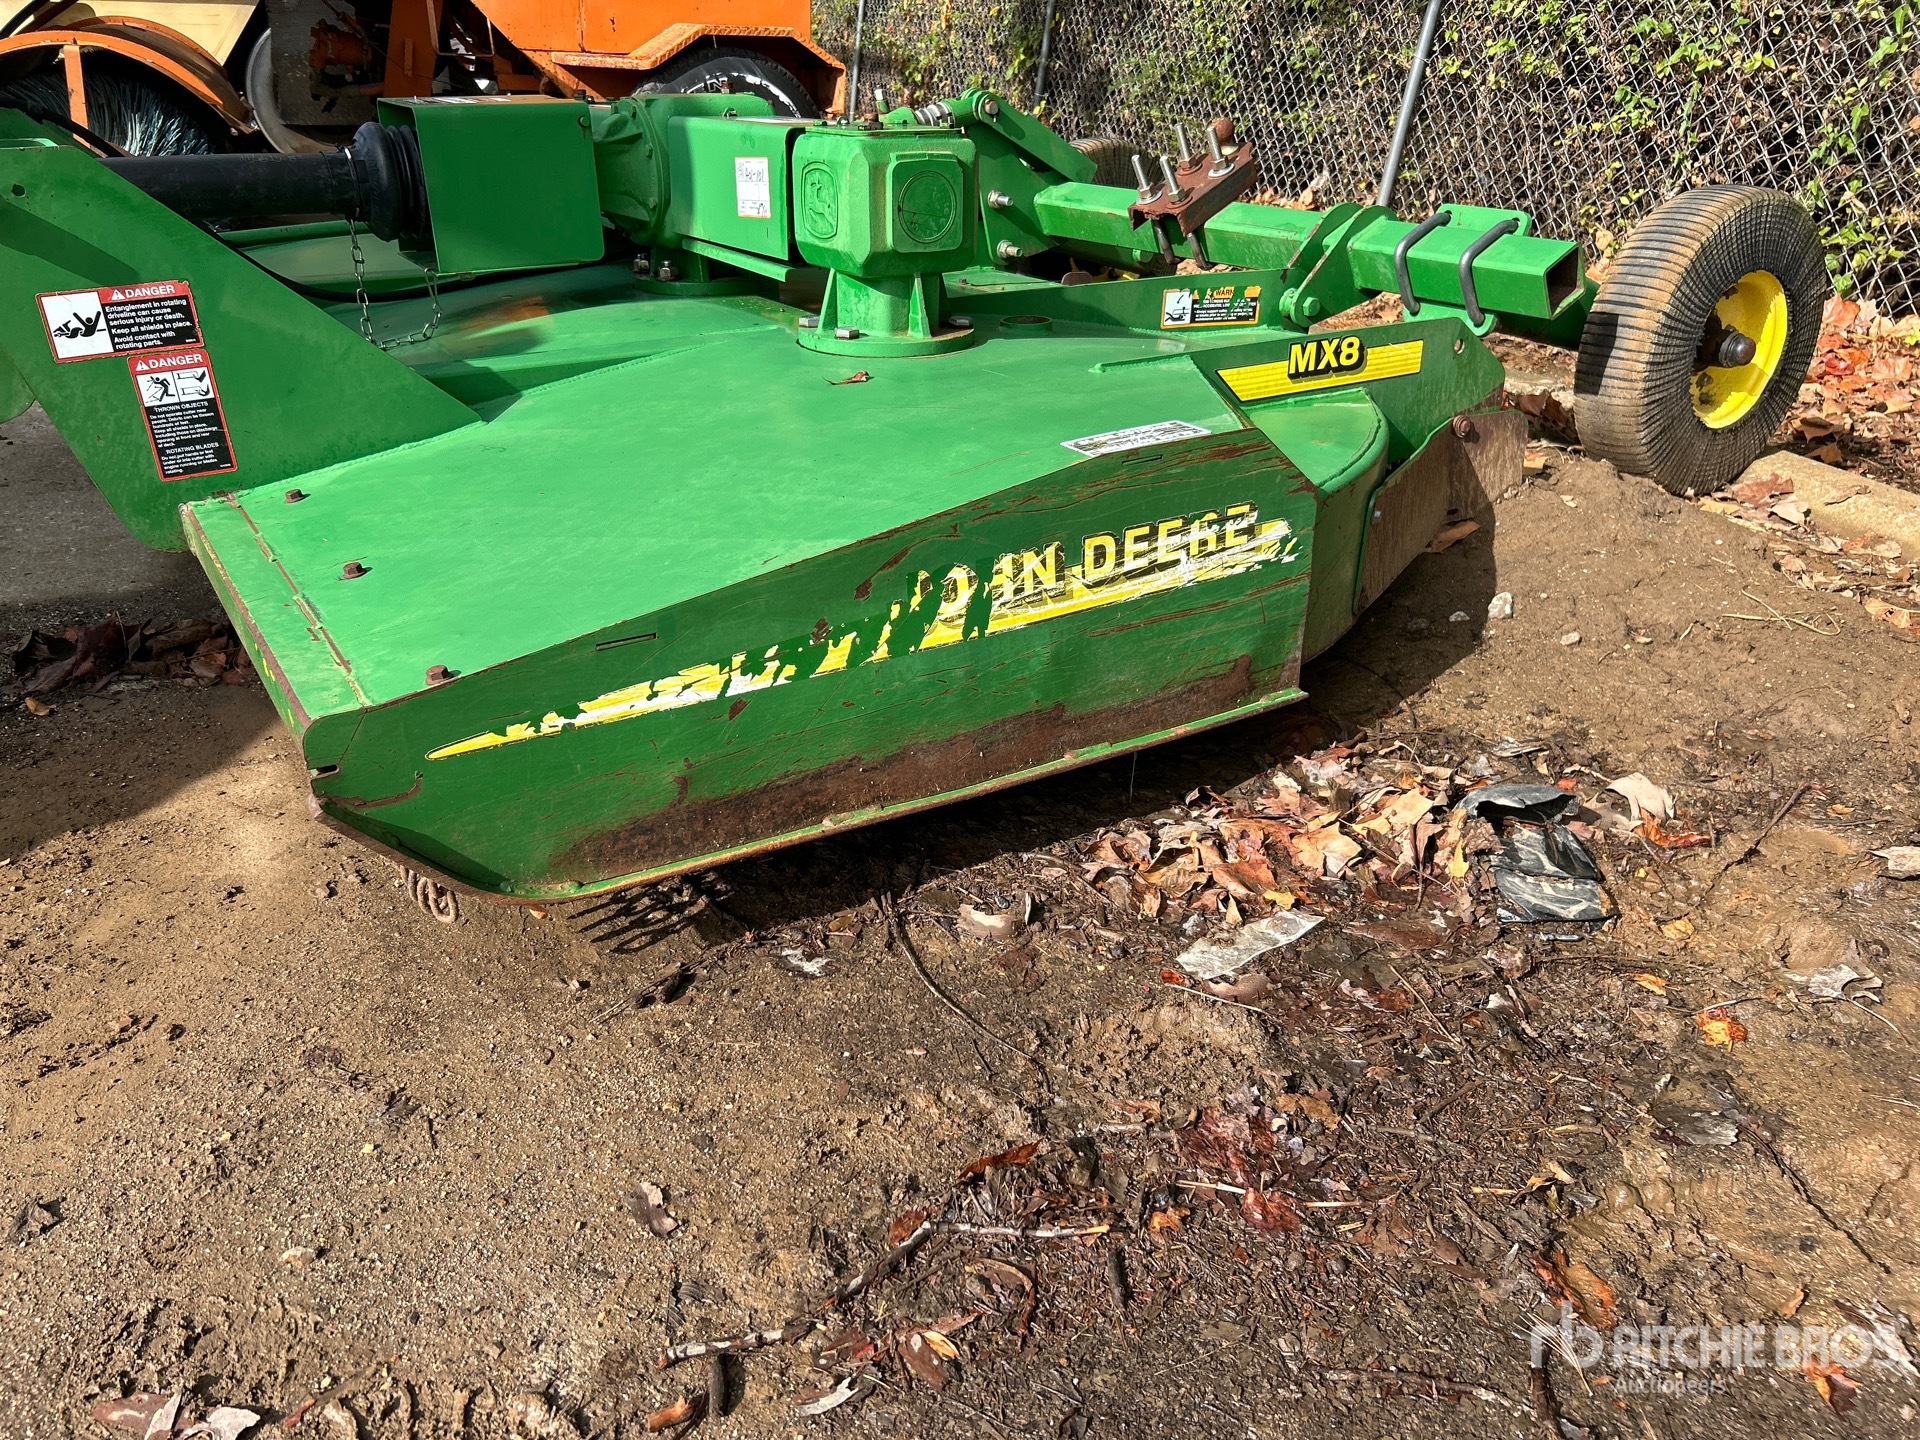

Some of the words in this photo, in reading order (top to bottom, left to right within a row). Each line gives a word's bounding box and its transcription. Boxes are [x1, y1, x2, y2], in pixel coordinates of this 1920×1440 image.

[125, 285, 175, 298] DANGER
[105, 302, 152, 312] Entanglement
[109, 318, 134, 326] serious
[135, 316, 154, 324] injury
[114, 335, 133, 343] Avoid
[135, 333, 160, 341] contact
[144, 340, 163, 348] parts.
[149, 354, 203, 368] DANGER
[1288, 336, 1361, 376] MX8
[155, 404, 180, 412] THROWN
[181, 401, 208, 409] OBJECTS
[166, 445, 195, 454] ROTATING
[196, 442, 219, 450] BLADES
